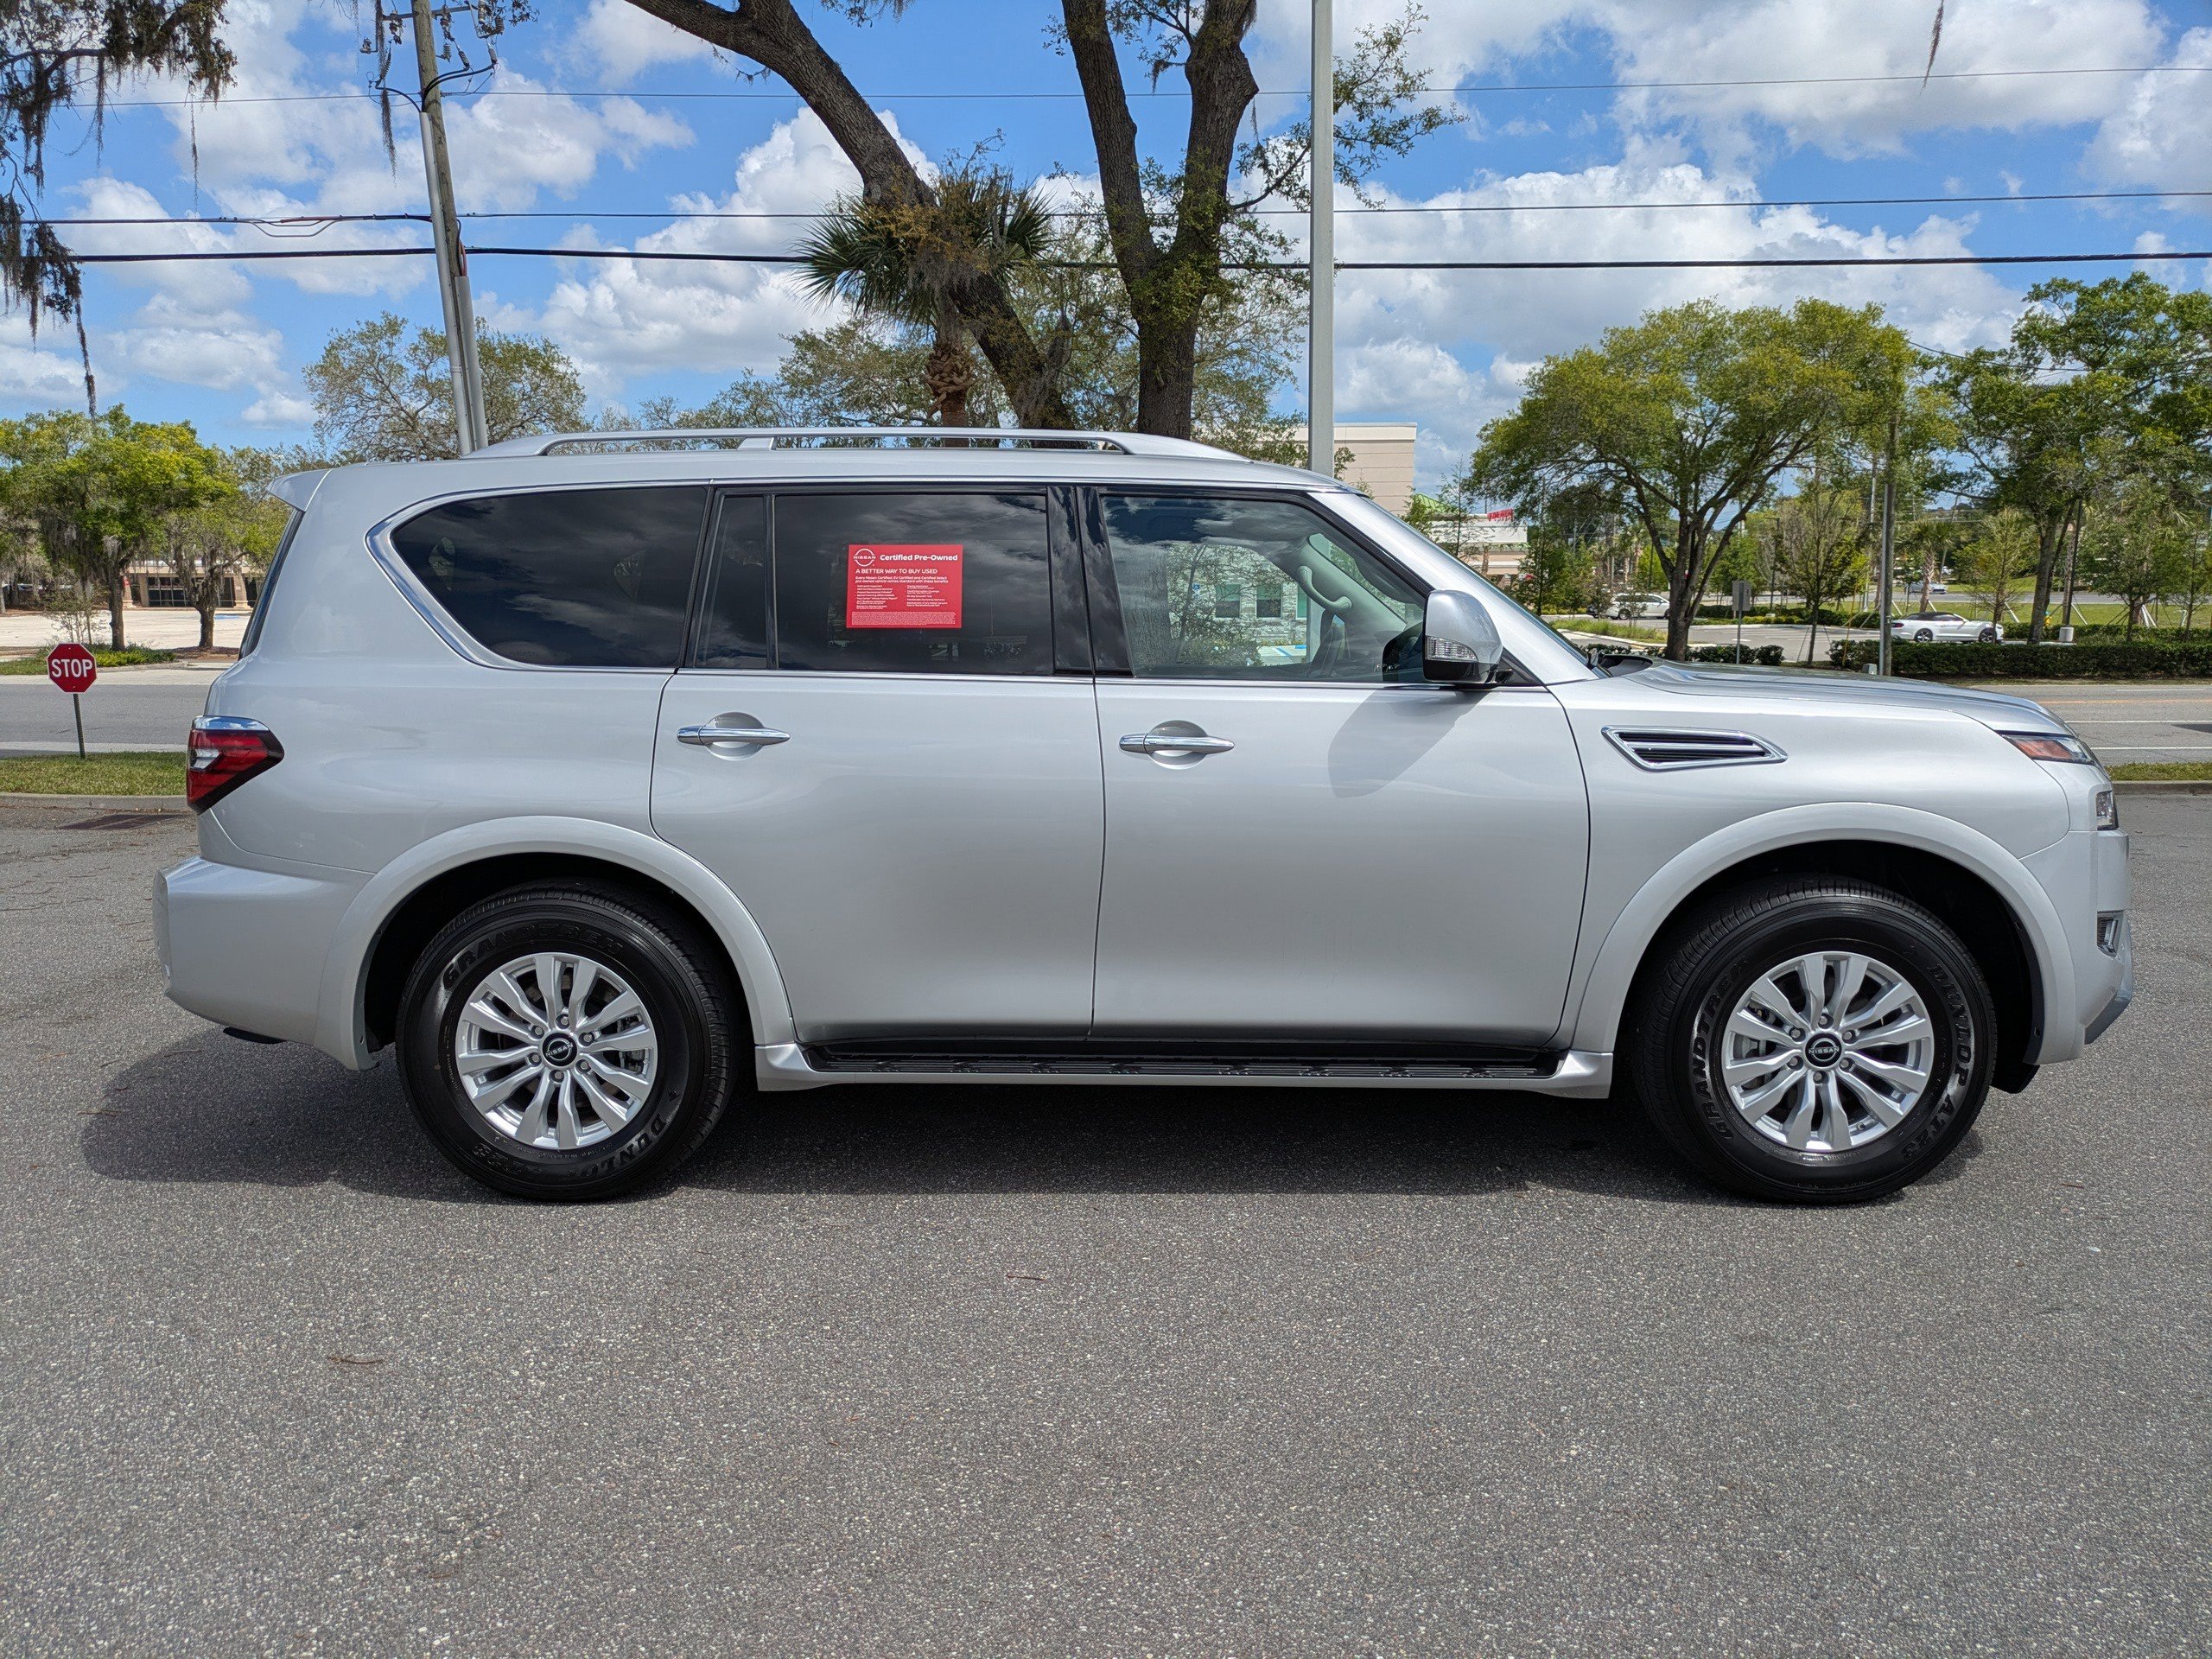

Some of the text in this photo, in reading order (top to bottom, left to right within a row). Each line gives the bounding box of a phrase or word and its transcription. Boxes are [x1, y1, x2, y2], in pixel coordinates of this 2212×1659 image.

[52, 658, 93, 677] STOP
[545, 1042, 574, 1057] NISSAN
[1808, 1046, 1840, 1055] NISSAN
[1901, 963, 1972, 1161] DUNLOP AT23
